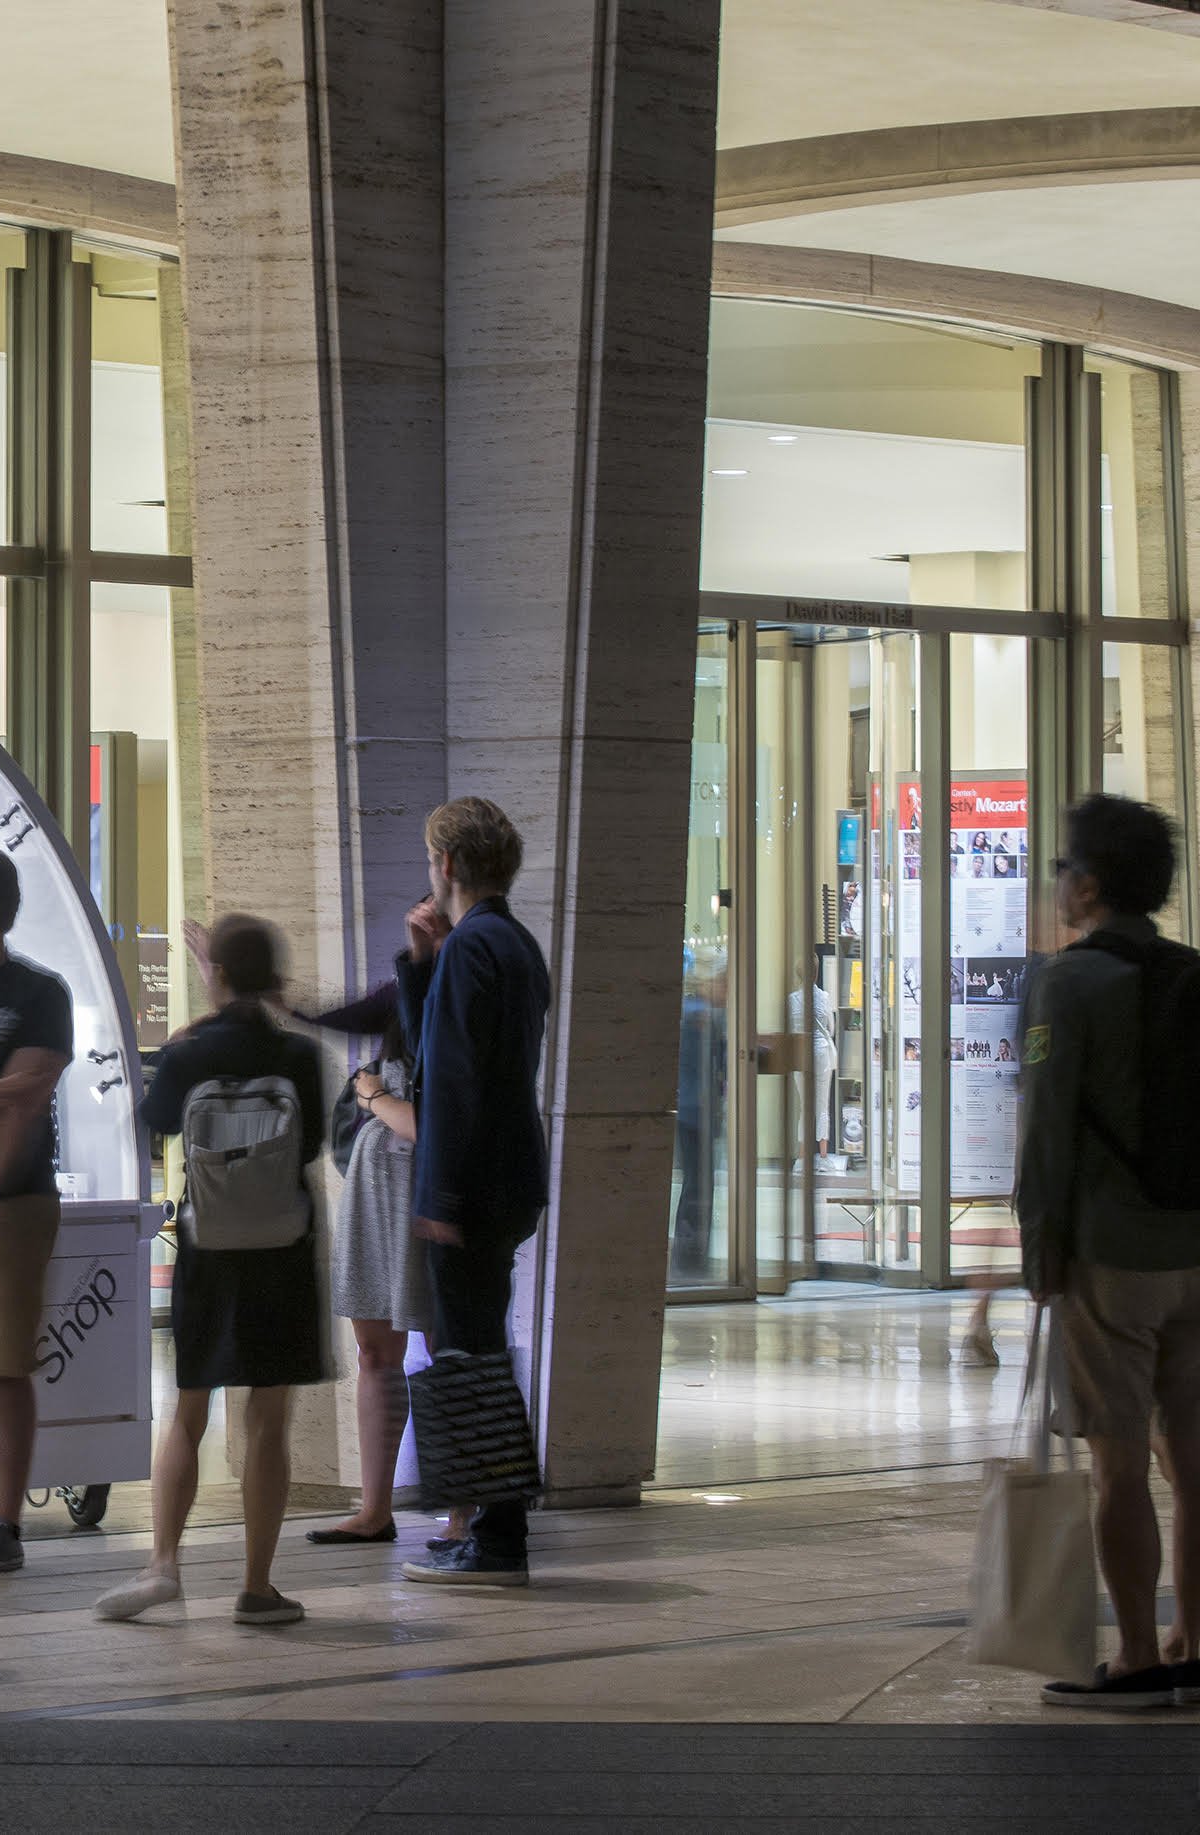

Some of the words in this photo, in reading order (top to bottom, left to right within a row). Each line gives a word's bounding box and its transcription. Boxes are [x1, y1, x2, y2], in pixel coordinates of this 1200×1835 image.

[785, 601, 828, 620] David
[950, 800, 974, 816] stly
[975, 797, 1028, 814] Mozart
[29, 1268, 117, 1384] Shop
